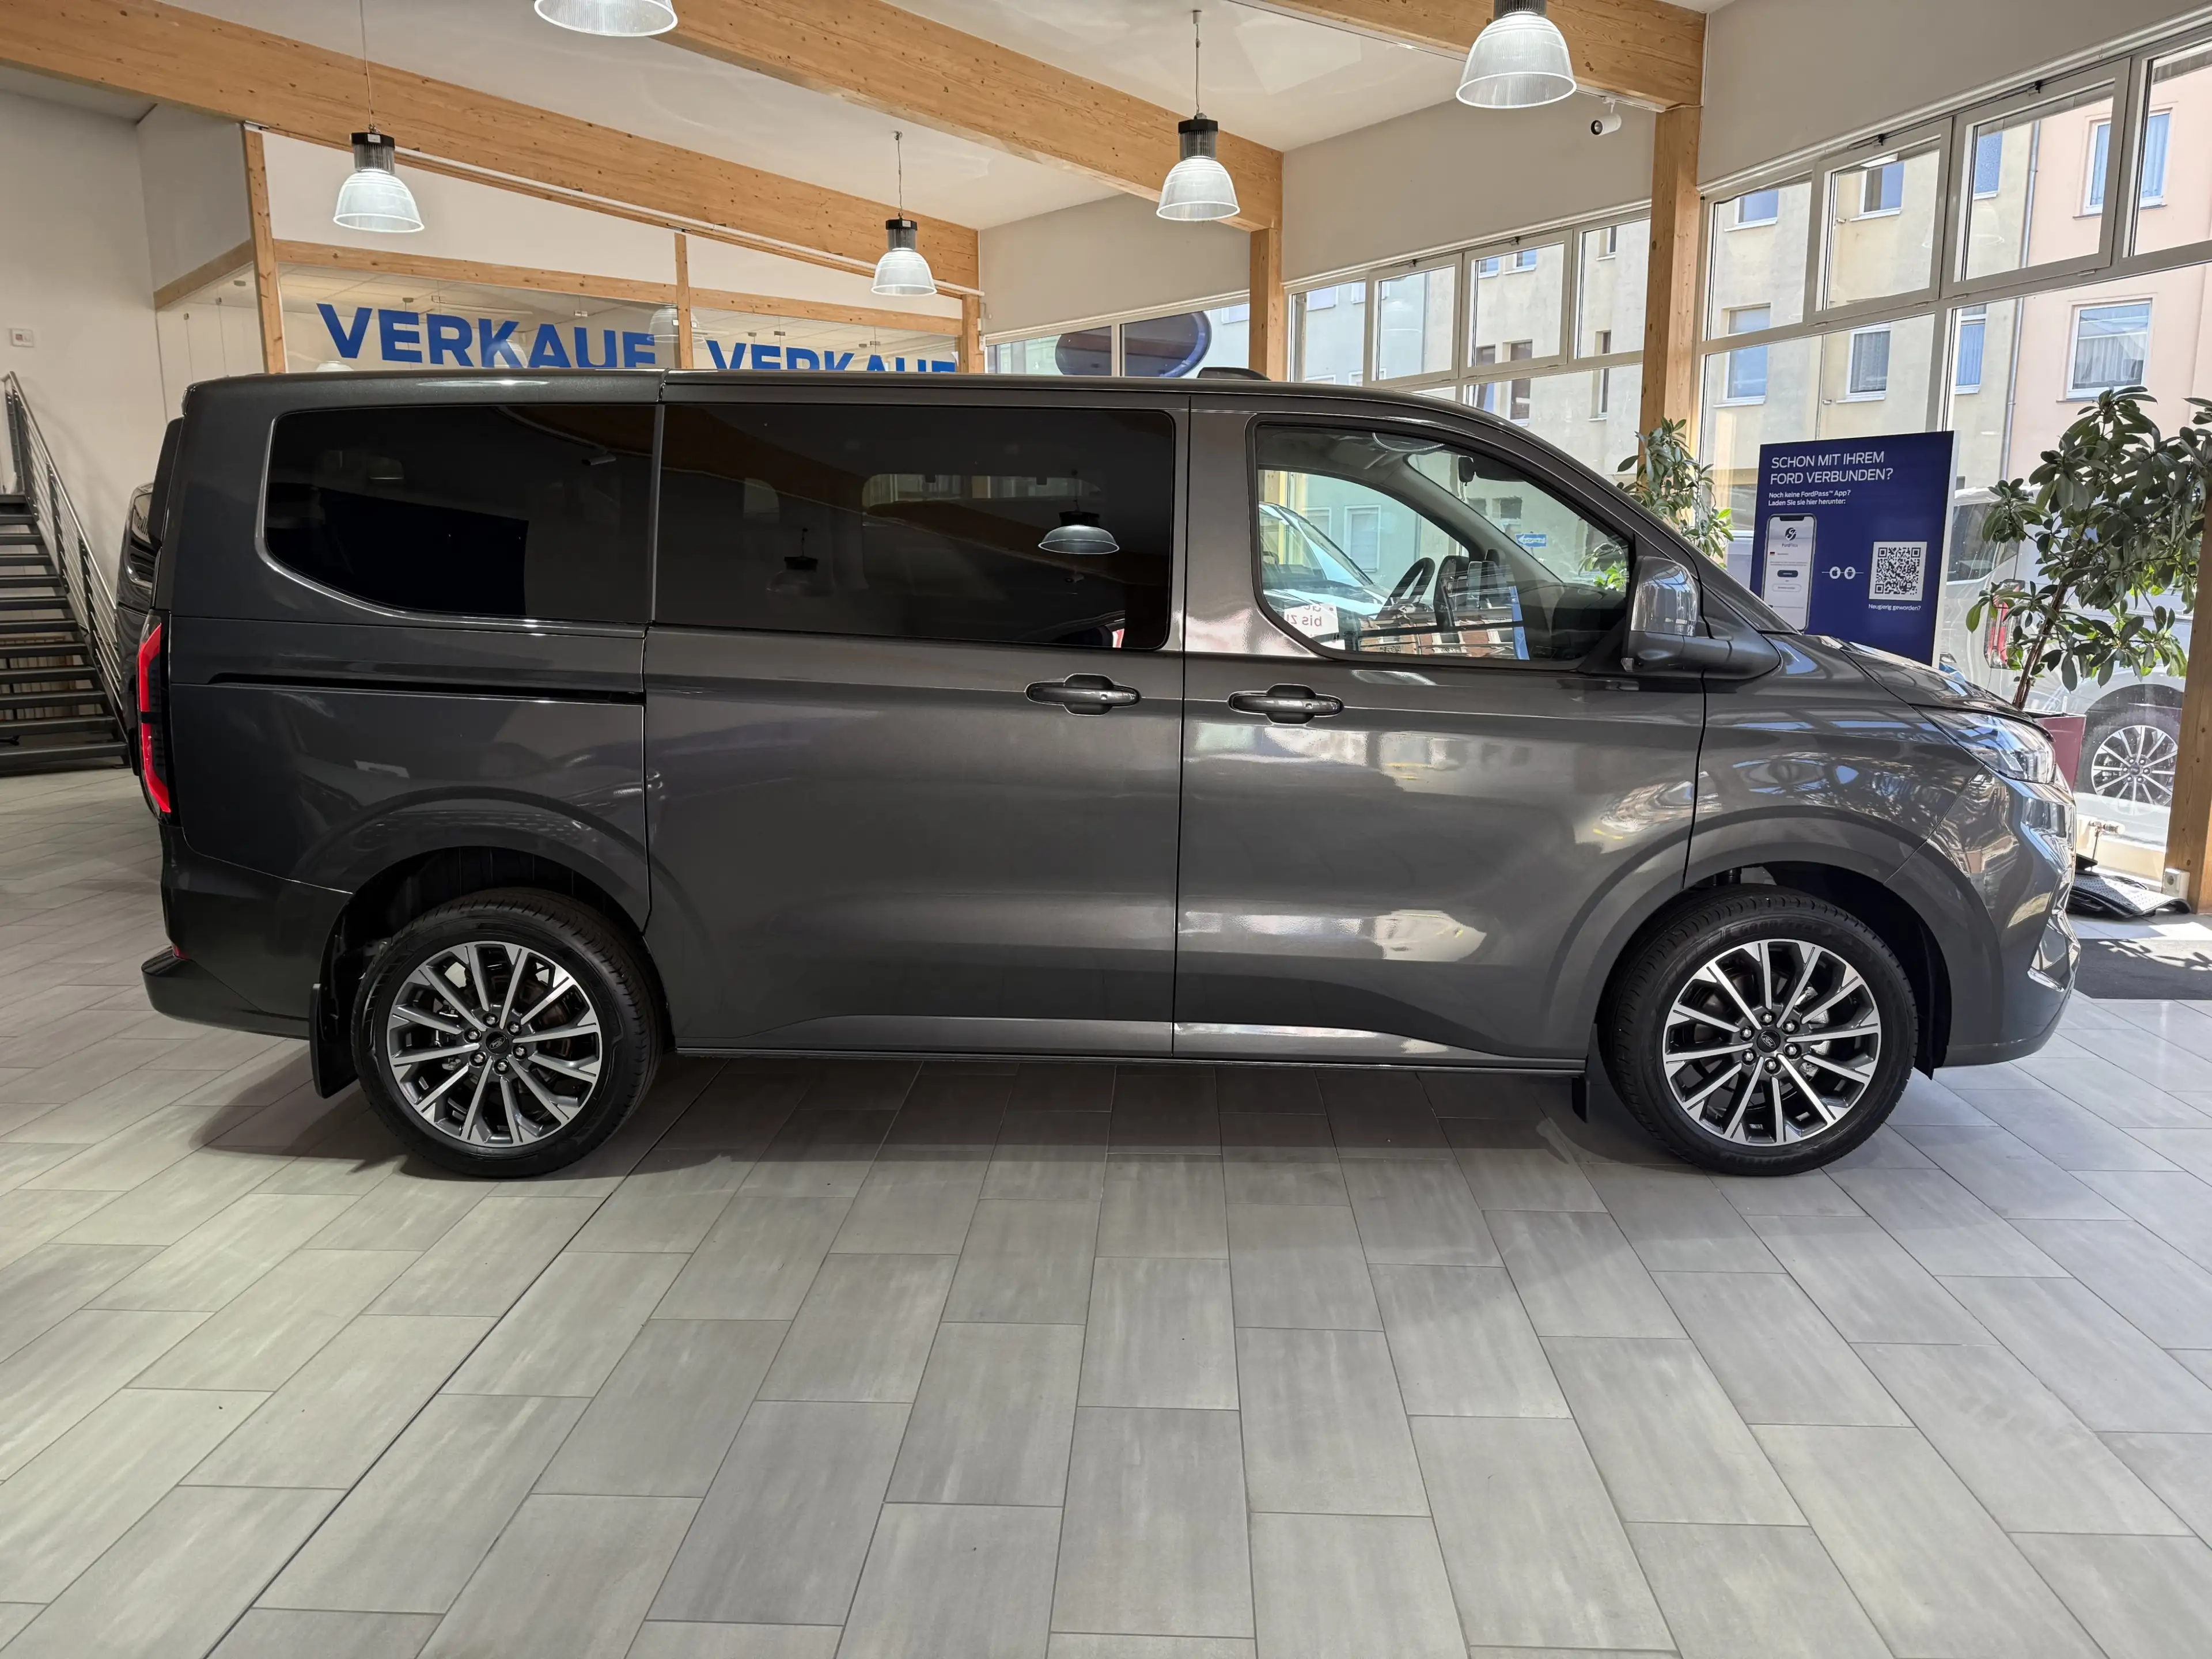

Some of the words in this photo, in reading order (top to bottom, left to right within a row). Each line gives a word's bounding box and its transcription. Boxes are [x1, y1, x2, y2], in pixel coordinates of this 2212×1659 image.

[316, 304, 655, 368] VERKAUF
[706, 340, 956, 373] VERK
[1771, 455, 1815, 468] SCHON
[1818, 454, 1841, 465] MIT
[1843, 451, 1884, 464] IHREM
[1770, 472, 1804, 484] FORD
[1806, 468, 1893, 483] VERBUNDEN?
